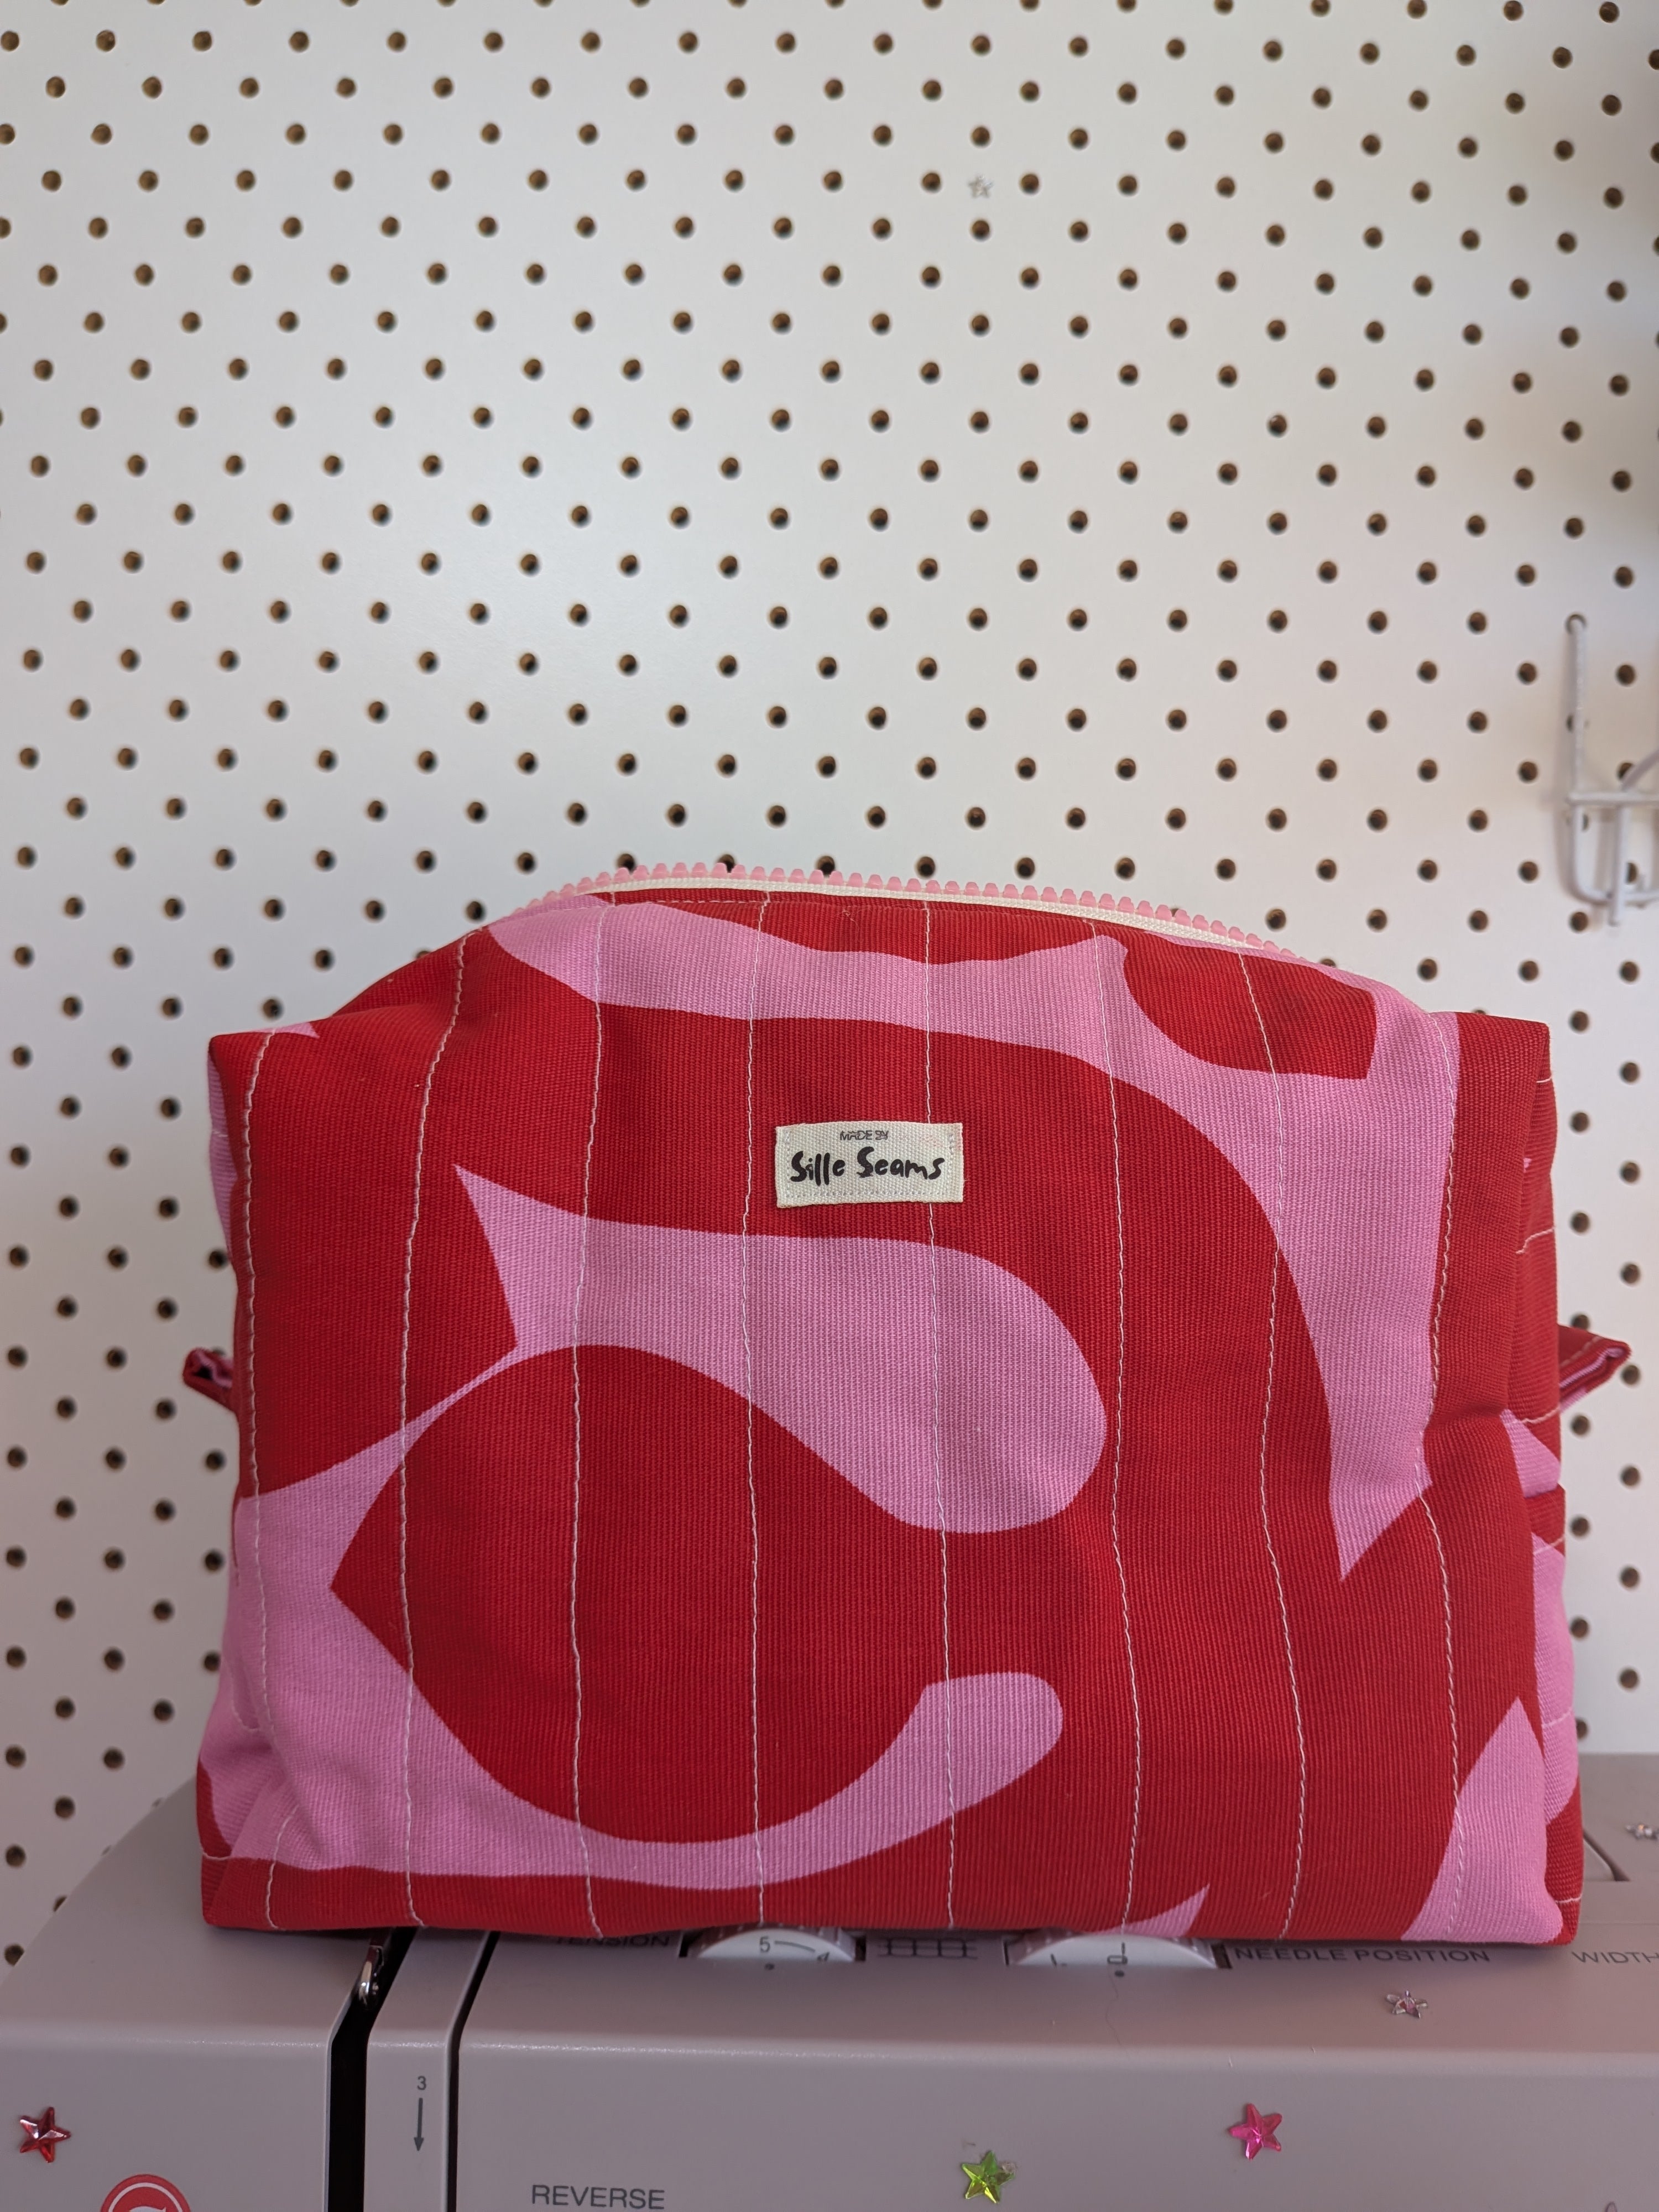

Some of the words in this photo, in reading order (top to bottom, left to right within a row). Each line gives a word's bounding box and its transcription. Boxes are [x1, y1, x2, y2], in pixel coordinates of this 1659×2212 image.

[839, 1130, 873, 1140] MADE
[874, 1130, 889, 1140] BY
[790, 1151, 846, 1186] Sille
[857, 1146, 945, 1180] Seams
[759, 1936, 770, 1953] 5
[1235, 1947, 1347, 1960] NEEDLE
[1354, 1949, 1490, 1962] POSITION
[417, 2075, 426, 2090] 3
[532, 2184, 665, 2209] REVERSE
